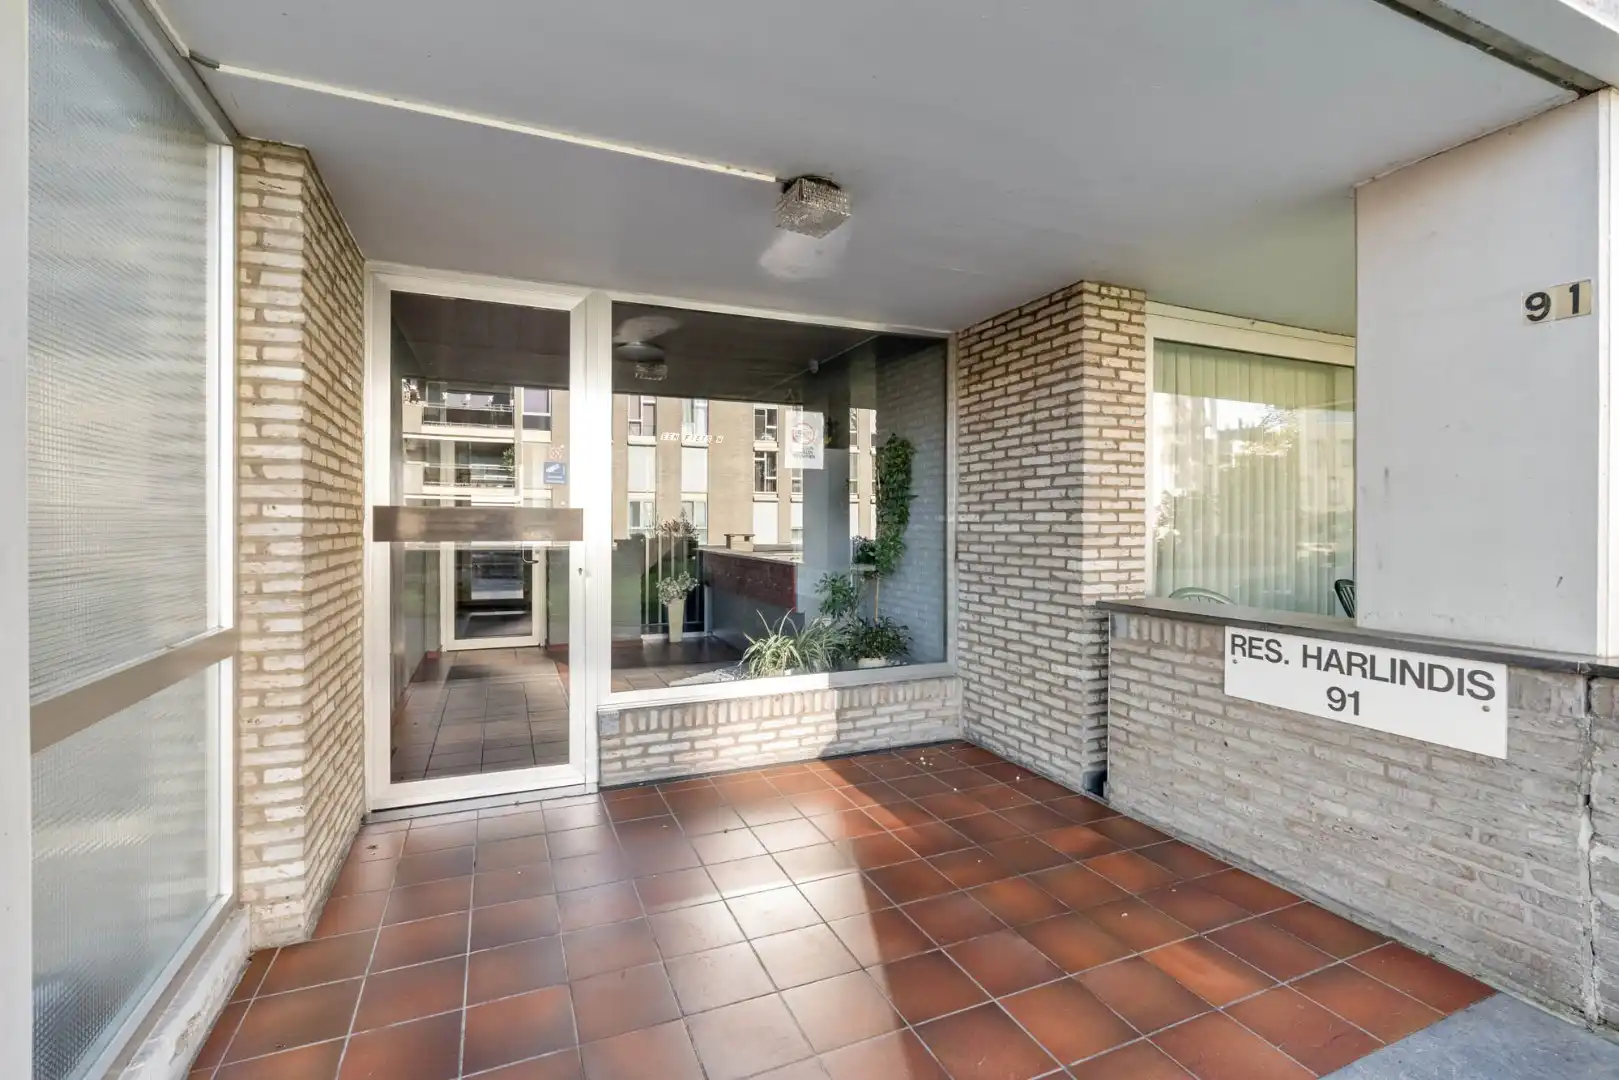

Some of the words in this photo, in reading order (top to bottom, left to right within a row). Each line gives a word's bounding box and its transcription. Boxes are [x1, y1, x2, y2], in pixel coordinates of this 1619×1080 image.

[1525, 282, 1580, 322] 91
[1230, 633, 1289, 665] RES.
[1302, 644, 1496, 701] HARLINDIS
[1326, 686, 1360, 716] 91
